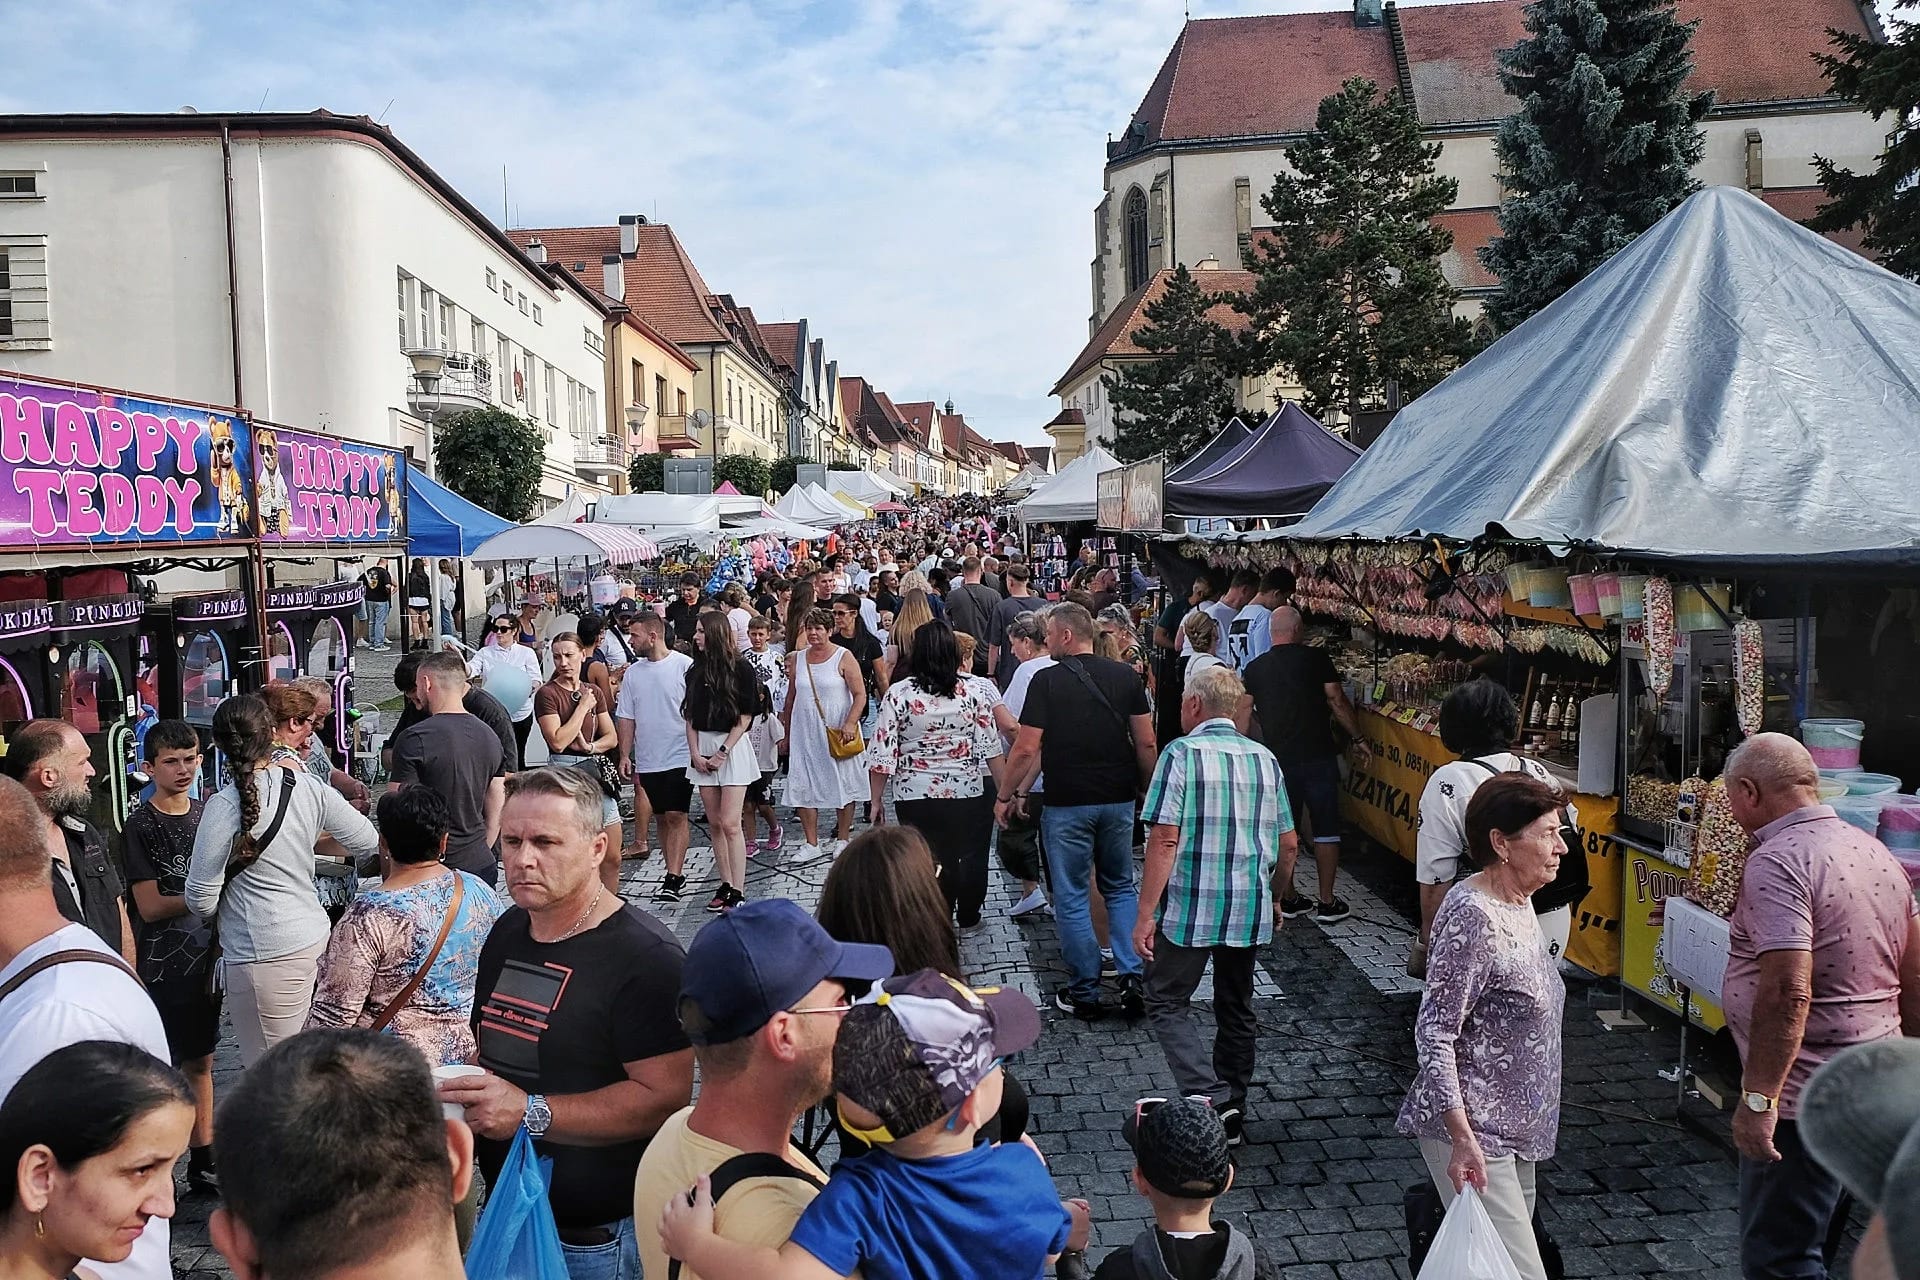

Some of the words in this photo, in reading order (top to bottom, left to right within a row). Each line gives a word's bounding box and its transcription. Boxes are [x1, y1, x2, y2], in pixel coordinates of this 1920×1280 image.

[0, 393, 201, 474] HAPPY
[290, 441, 380, 495] HAPPY
[13, 468, 201, 536] TEDDY
[298, 491, 381, 537] TEDDY
[202, 599, 237, 615] PINK
[270, 592, 303, 606] PINK
[1387, 744, 1402, 767] 30,
[1405, 751, 1422, 772] 085
[1344, 762, 1414, 832] ÍZATKA,
